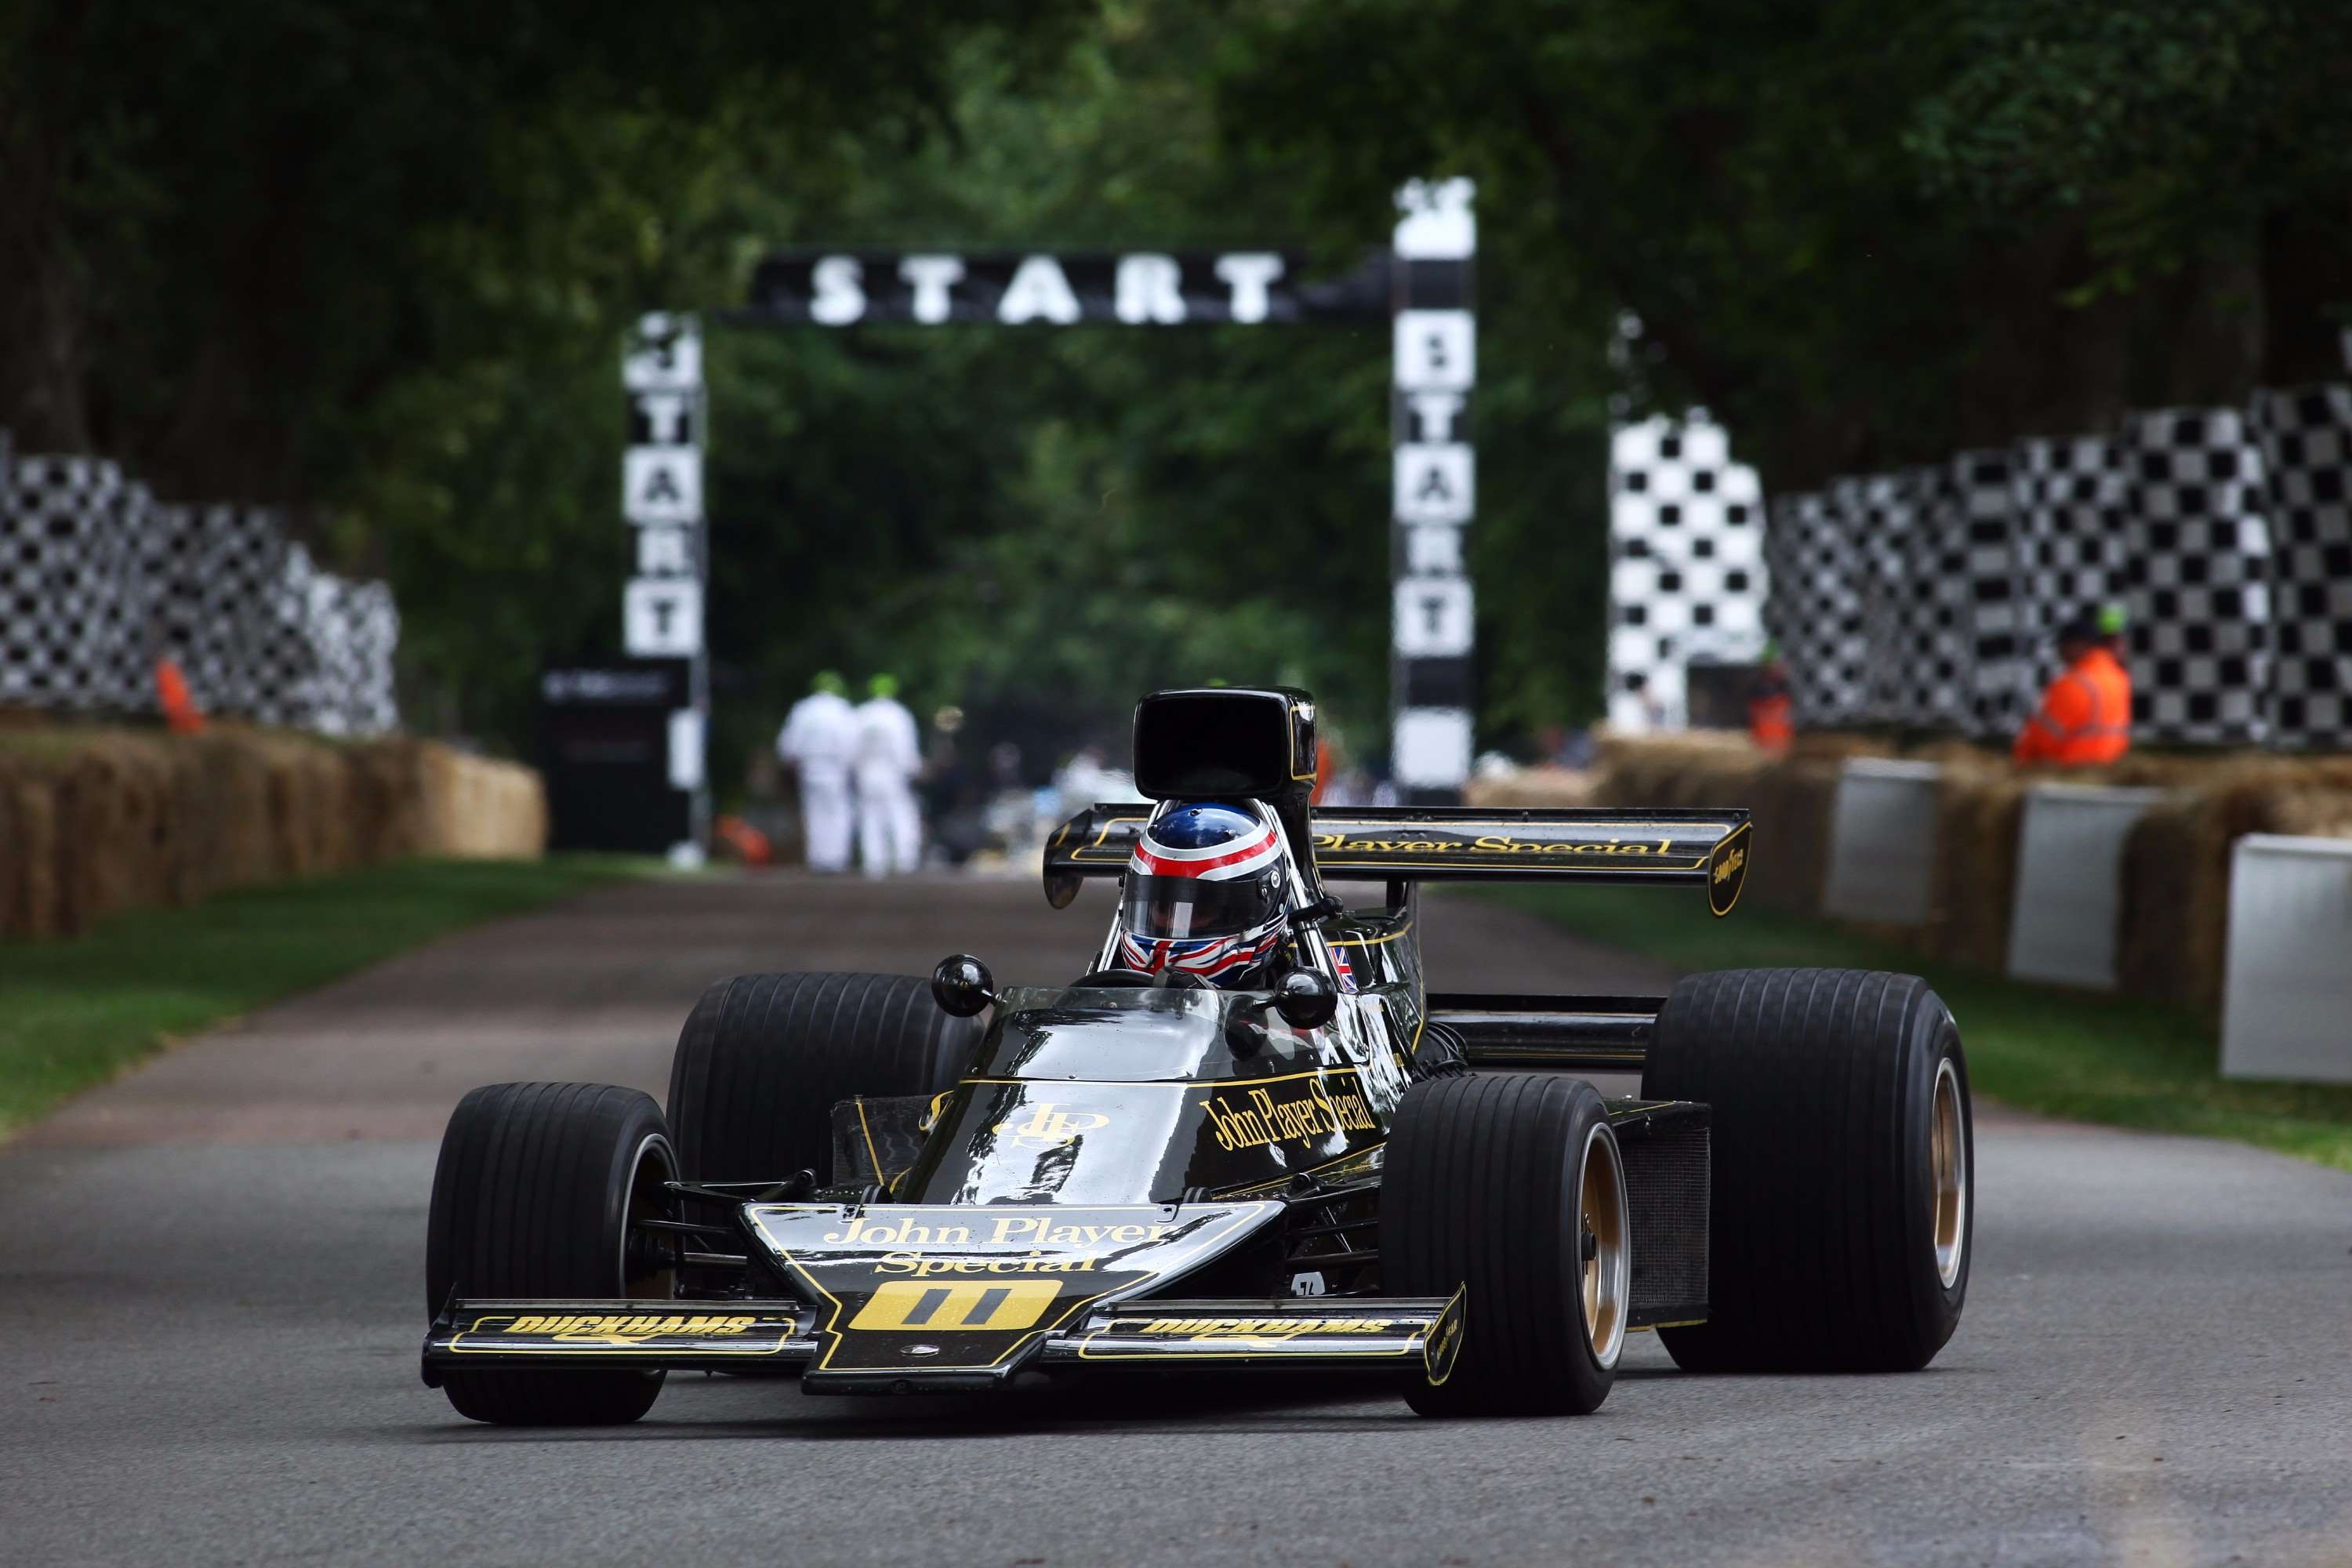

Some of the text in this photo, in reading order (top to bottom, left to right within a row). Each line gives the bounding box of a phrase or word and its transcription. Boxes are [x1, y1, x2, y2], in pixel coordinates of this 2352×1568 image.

[809, 252, 1284, 326] START
[1406, 331, 1468, 637] START
[1199, 1076, 1376, 1152] John Player Special
[822, 1216, 1180, 1277] John Player Special
[503, 1316, 757, 1334] DUCKHAMS
[901, 1288, 1012, 1325] 11
[1139, 1318, 1393, 1334] DUCKHAMS
